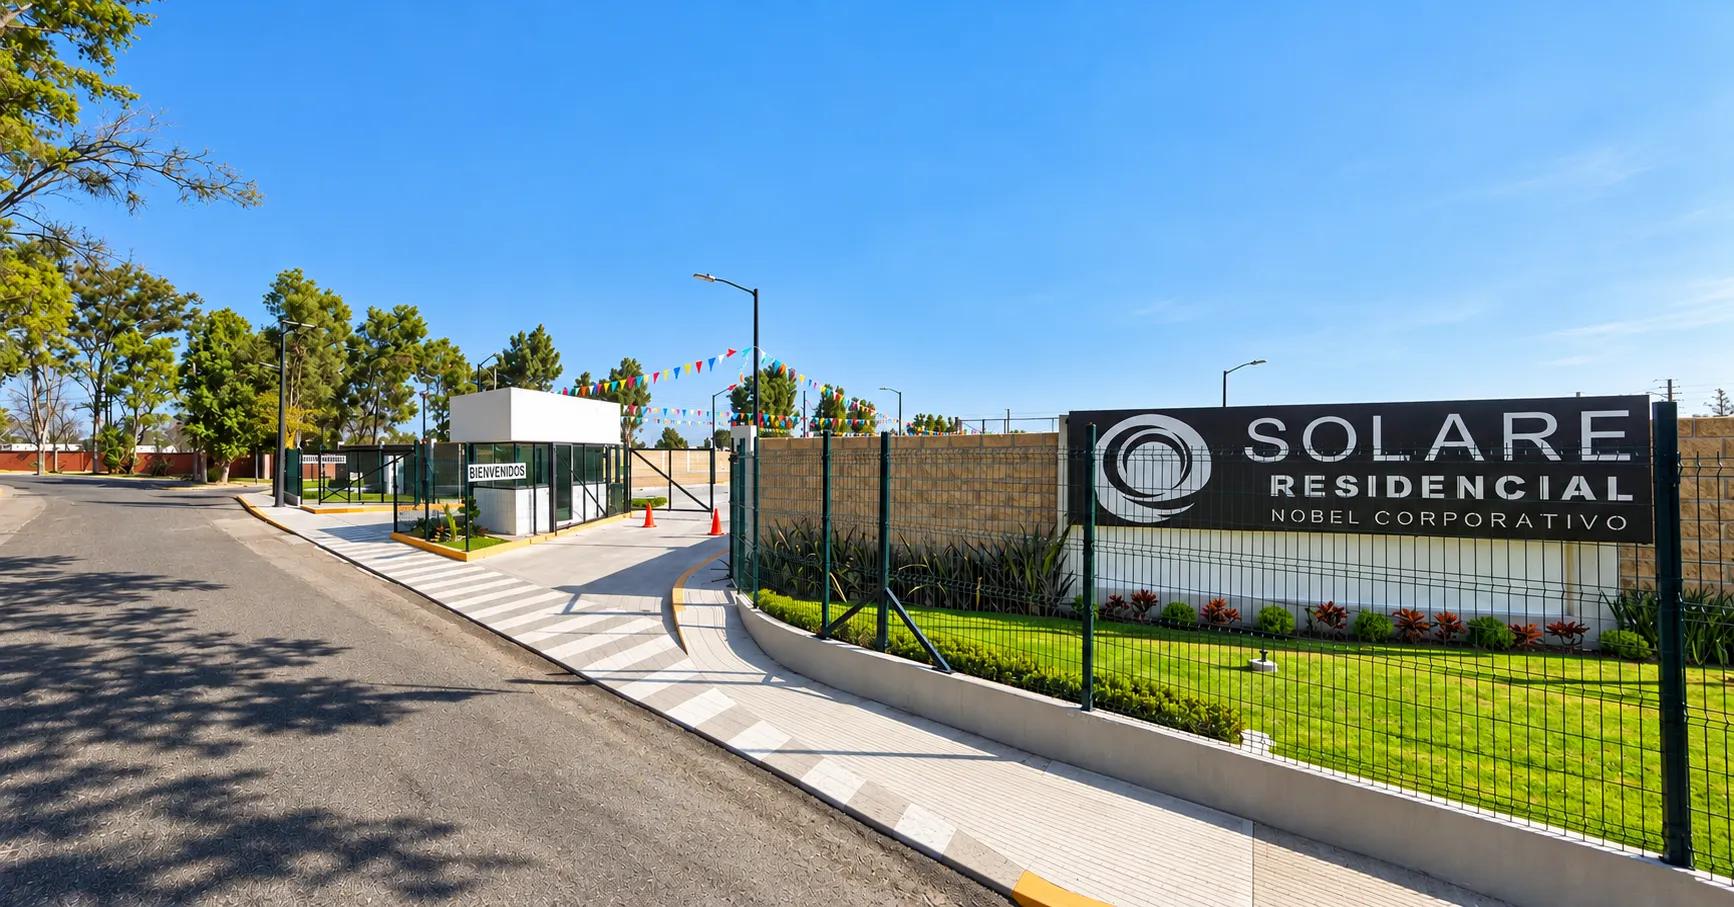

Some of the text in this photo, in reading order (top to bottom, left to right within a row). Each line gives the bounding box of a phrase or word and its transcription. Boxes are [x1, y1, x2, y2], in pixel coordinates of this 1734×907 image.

[1244, 409, 1631, 463] SOLARE
[470, 465, 525, 479] BIENVENIDOS
[1270, 474, 1633, 502] RESIDENCIAL
[1271, 508, 1627, 532] NOBEL CORPORATIVO
